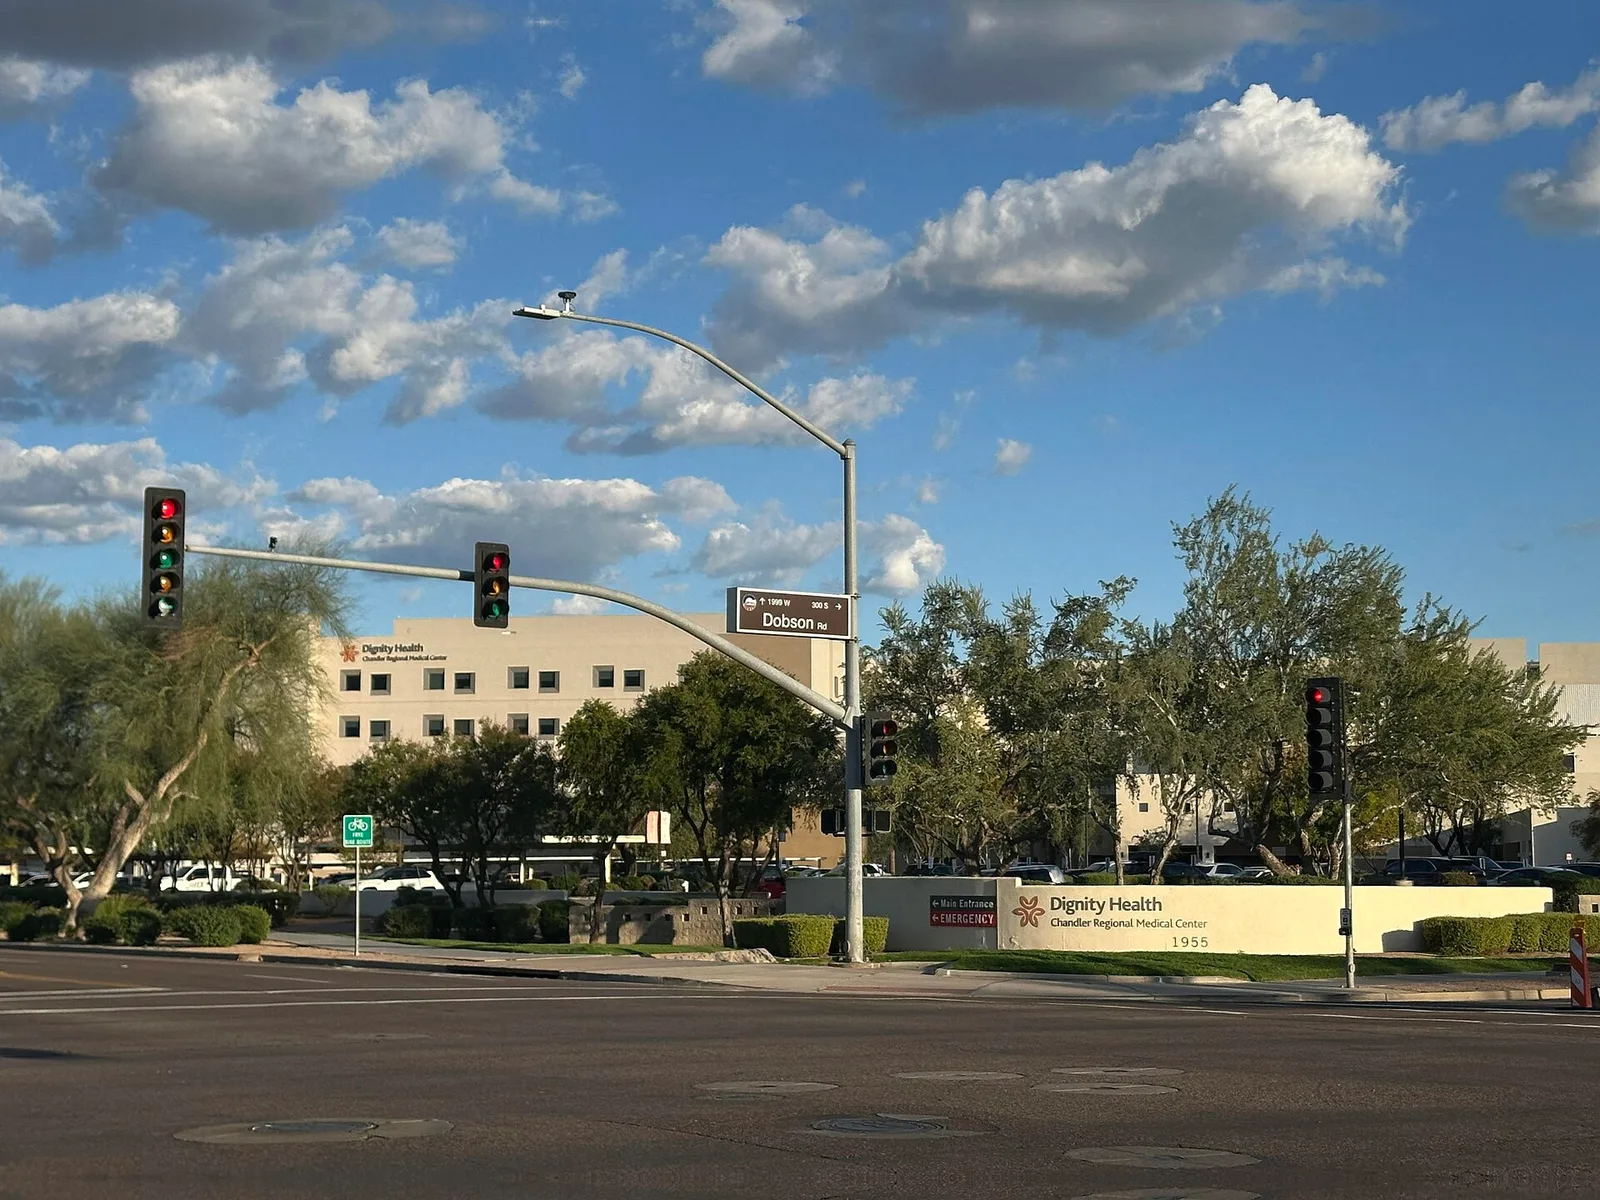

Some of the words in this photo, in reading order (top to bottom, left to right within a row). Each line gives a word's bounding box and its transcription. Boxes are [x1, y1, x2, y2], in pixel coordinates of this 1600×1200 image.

[763, 612, 814, 630] Dobson
[817, 622, 827, 630] Rd
[362, 644, 393, 654] Dignity
[395, 643, 424, 652] Health
[940, 899, 956, 908] Main
[959, 900, 994, 908] Entrance
[1050, 896, 1106, 915] Dignity
[1110, 896, 1162, 912] Health
[940, 914, 994, 924] EMERGENCY
[1050, 918, 1091, 928] Chandler
[1094, 918, 1133, 930] Regional
[1136, 919, 1173, 928] Medical
[1175, 919, 1208, 928] Center
[1172, 936, 1208, 948] 1955
